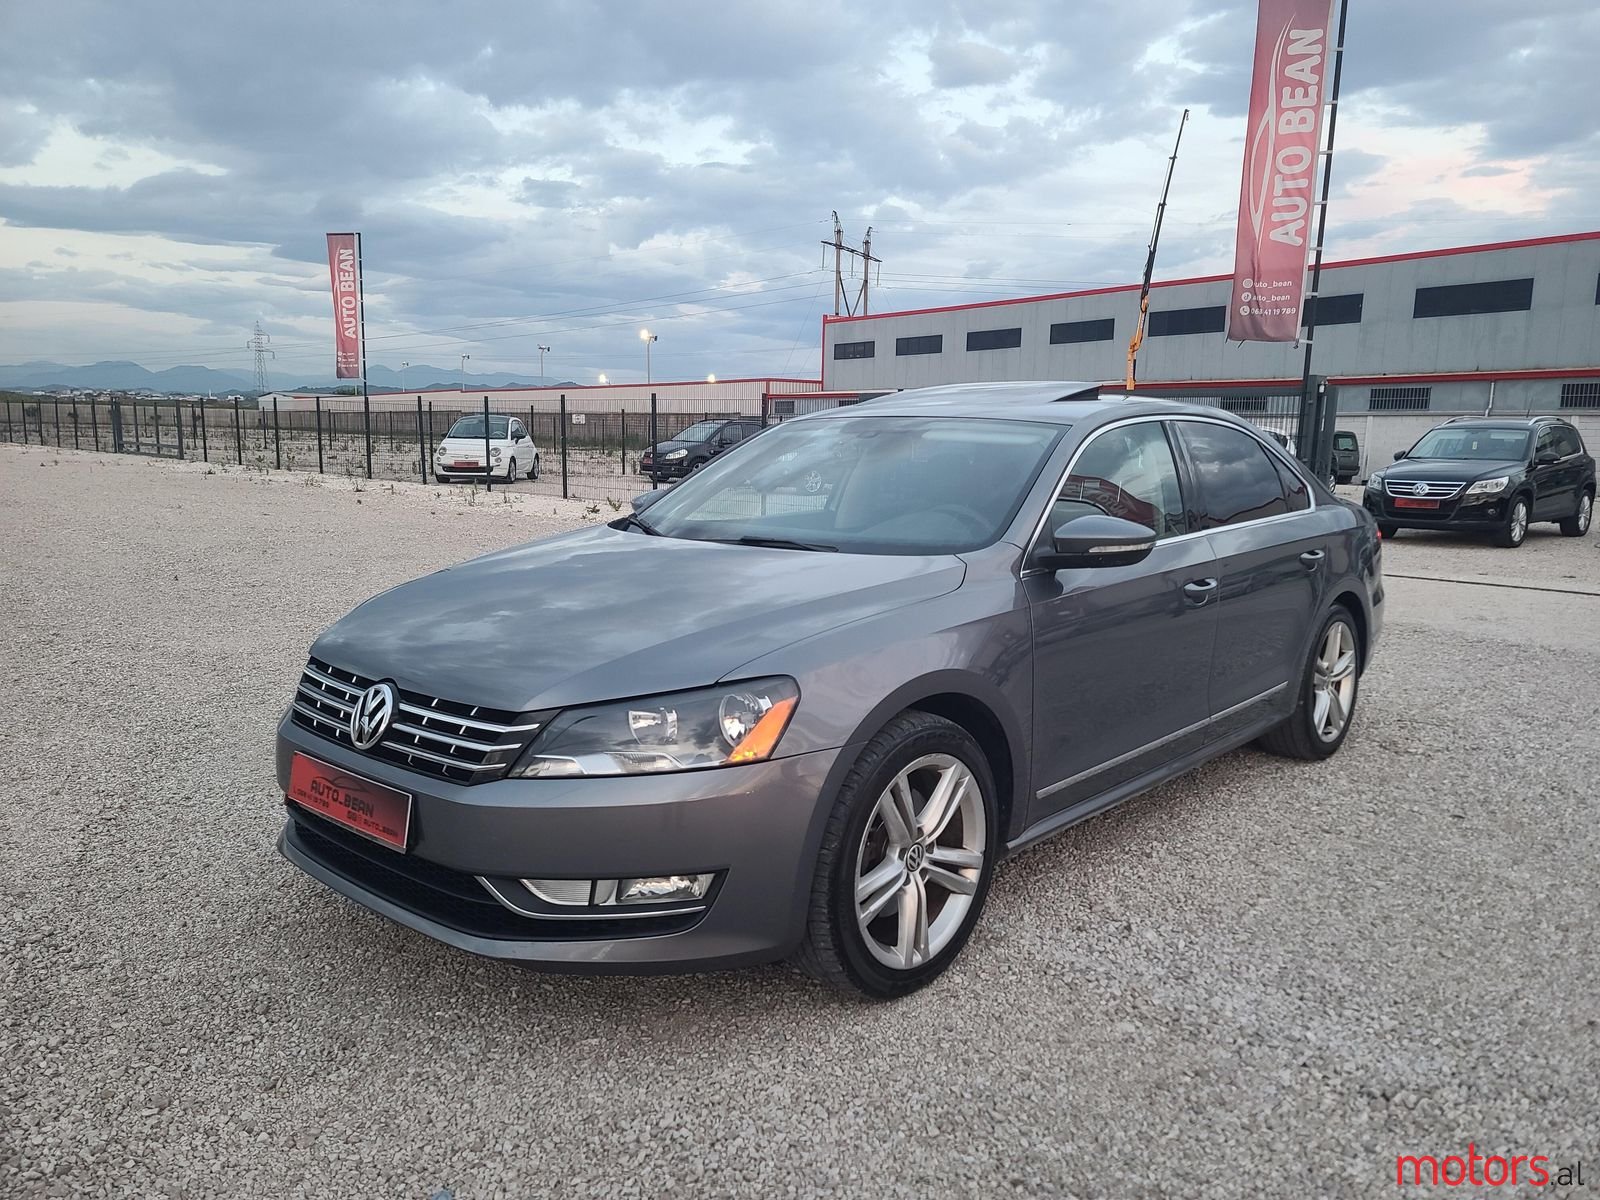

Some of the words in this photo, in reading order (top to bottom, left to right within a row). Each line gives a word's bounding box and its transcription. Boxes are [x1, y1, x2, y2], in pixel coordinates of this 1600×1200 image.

[1278, 28, 1324, 134] BEAN
[1270, 146, 1312, 247] AUTO
[340, 249, 355, 292] BEAN
[1254, 280, 1292, 289] uto_bean
[342, 296, 357, 339] AUTO
[1281, 307, 1296, 315] 789
